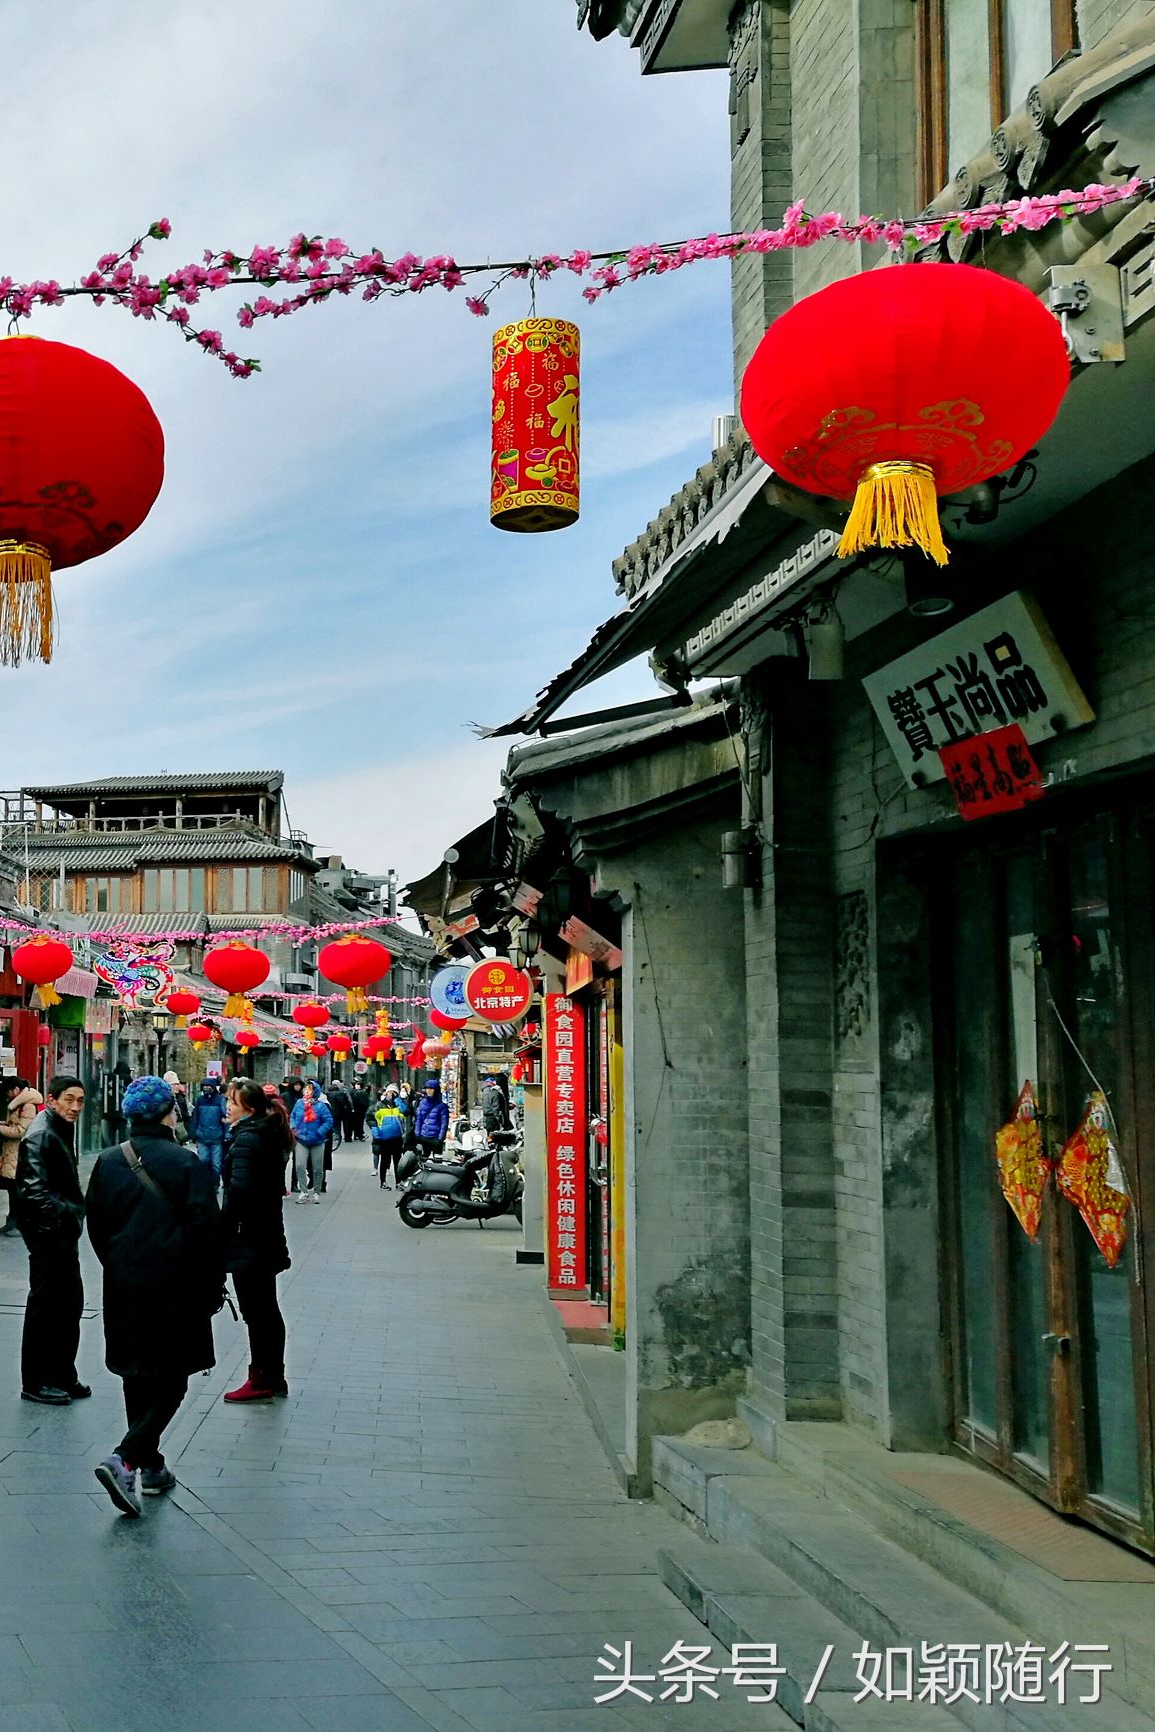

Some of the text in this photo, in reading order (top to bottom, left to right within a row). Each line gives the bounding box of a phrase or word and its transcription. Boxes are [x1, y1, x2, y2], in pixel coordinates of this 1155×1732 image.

[474, 996, 524, 1009] 北京特产
[555, 997, 576, 1285] 御食园直营专卖店 绿色休闲健康食品
